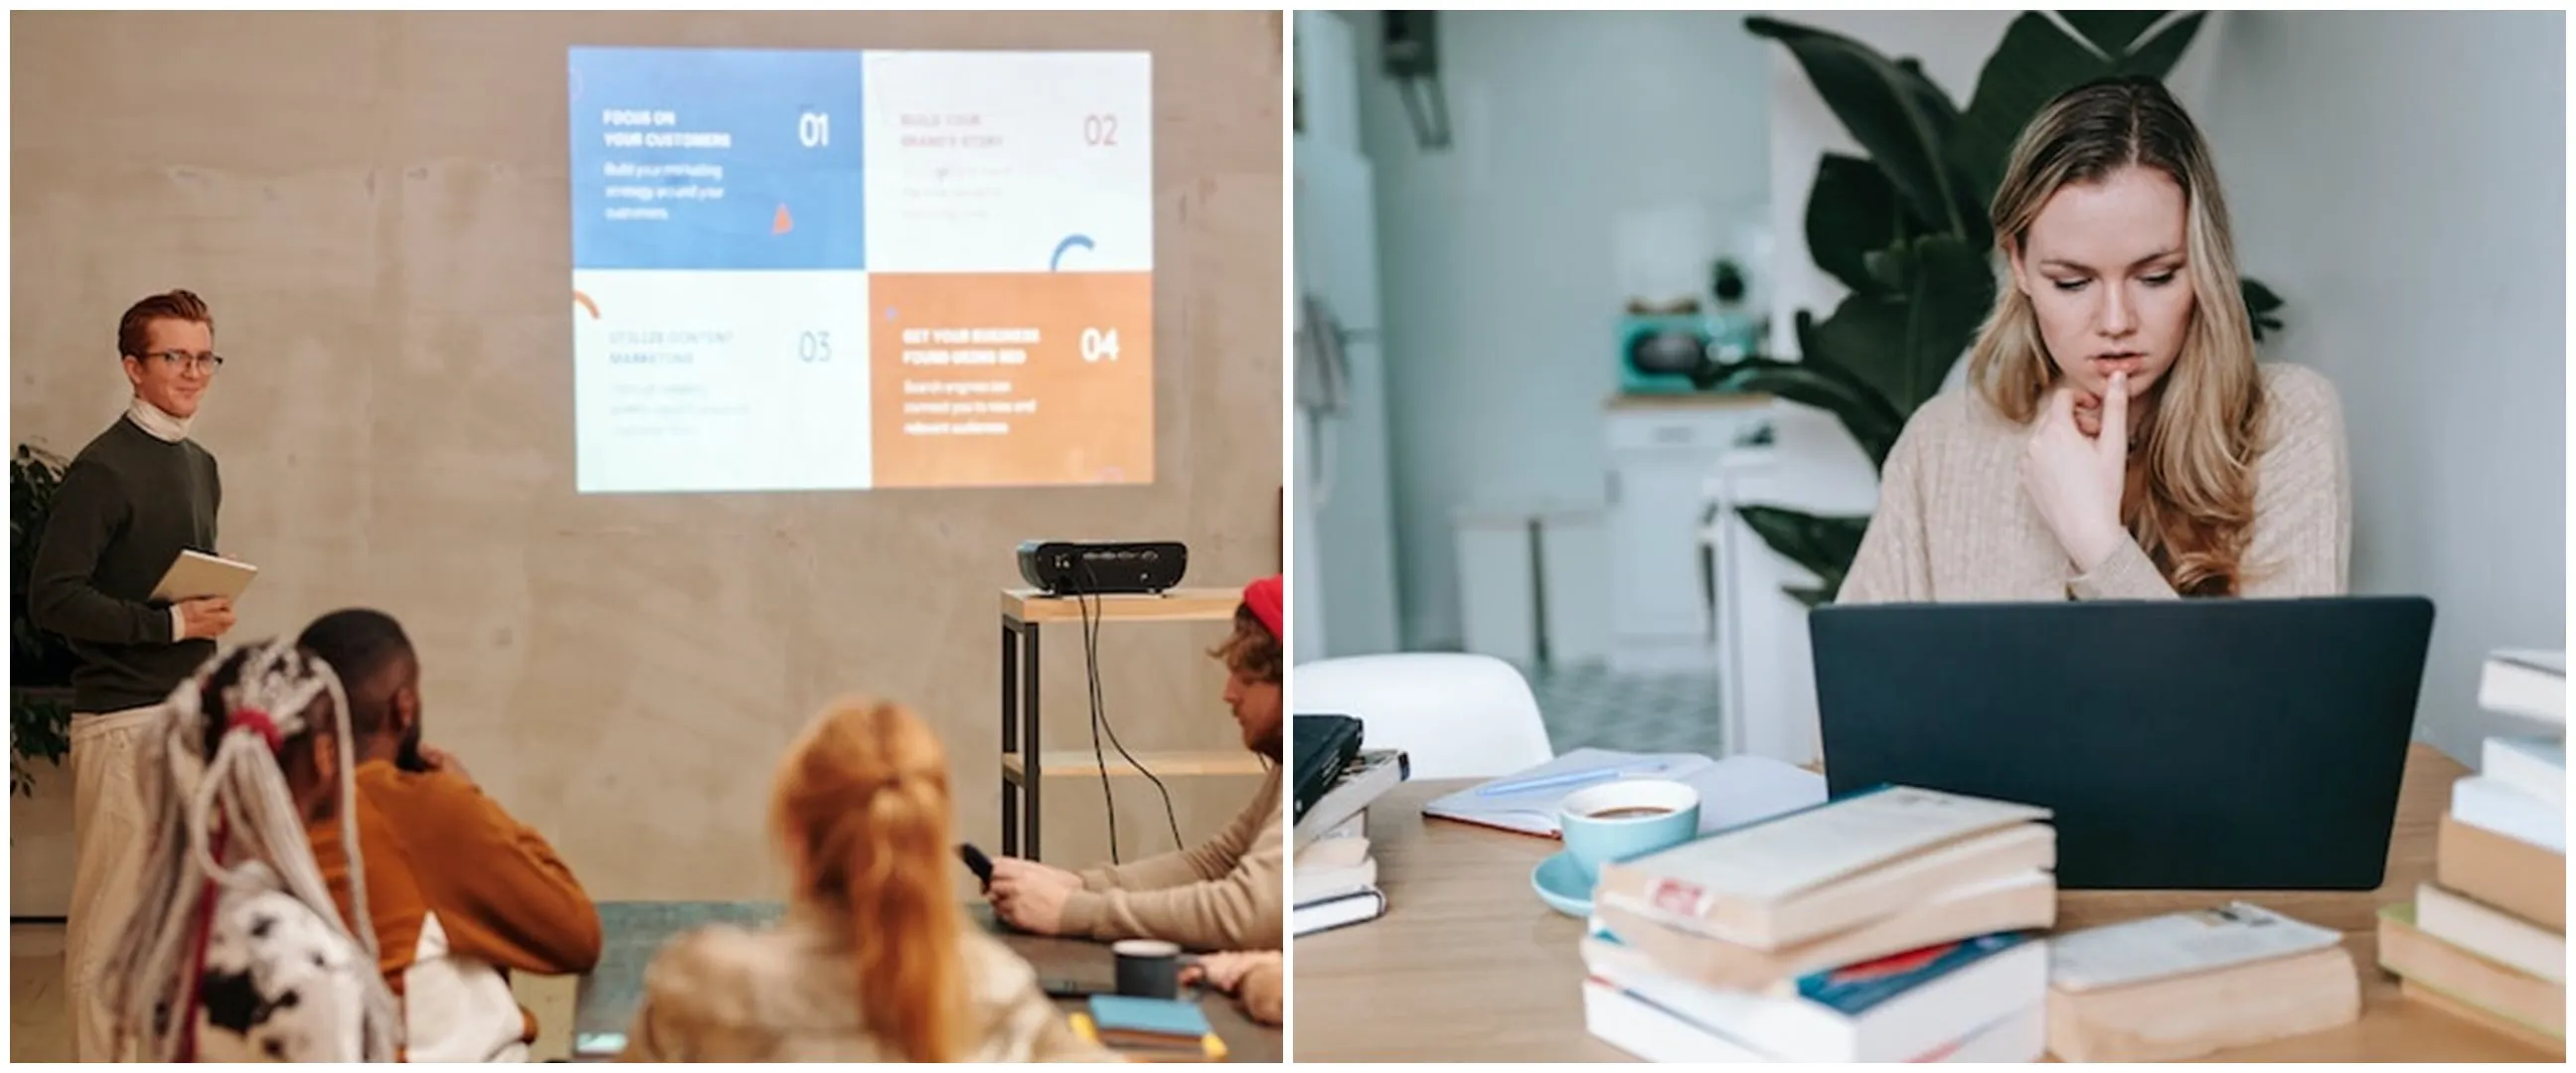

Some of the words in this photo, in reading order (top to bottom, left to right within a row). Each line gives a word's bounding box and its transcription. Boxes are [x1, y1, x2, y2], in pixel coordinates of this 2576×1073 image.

[603, 132, 643, 147] YOUR
[799, 111, 830, 147] 01
[1083, 113, 1118, 147] 02
[799, 330, 832, 363] 03
[1079, 327, 1121, 363] 04
